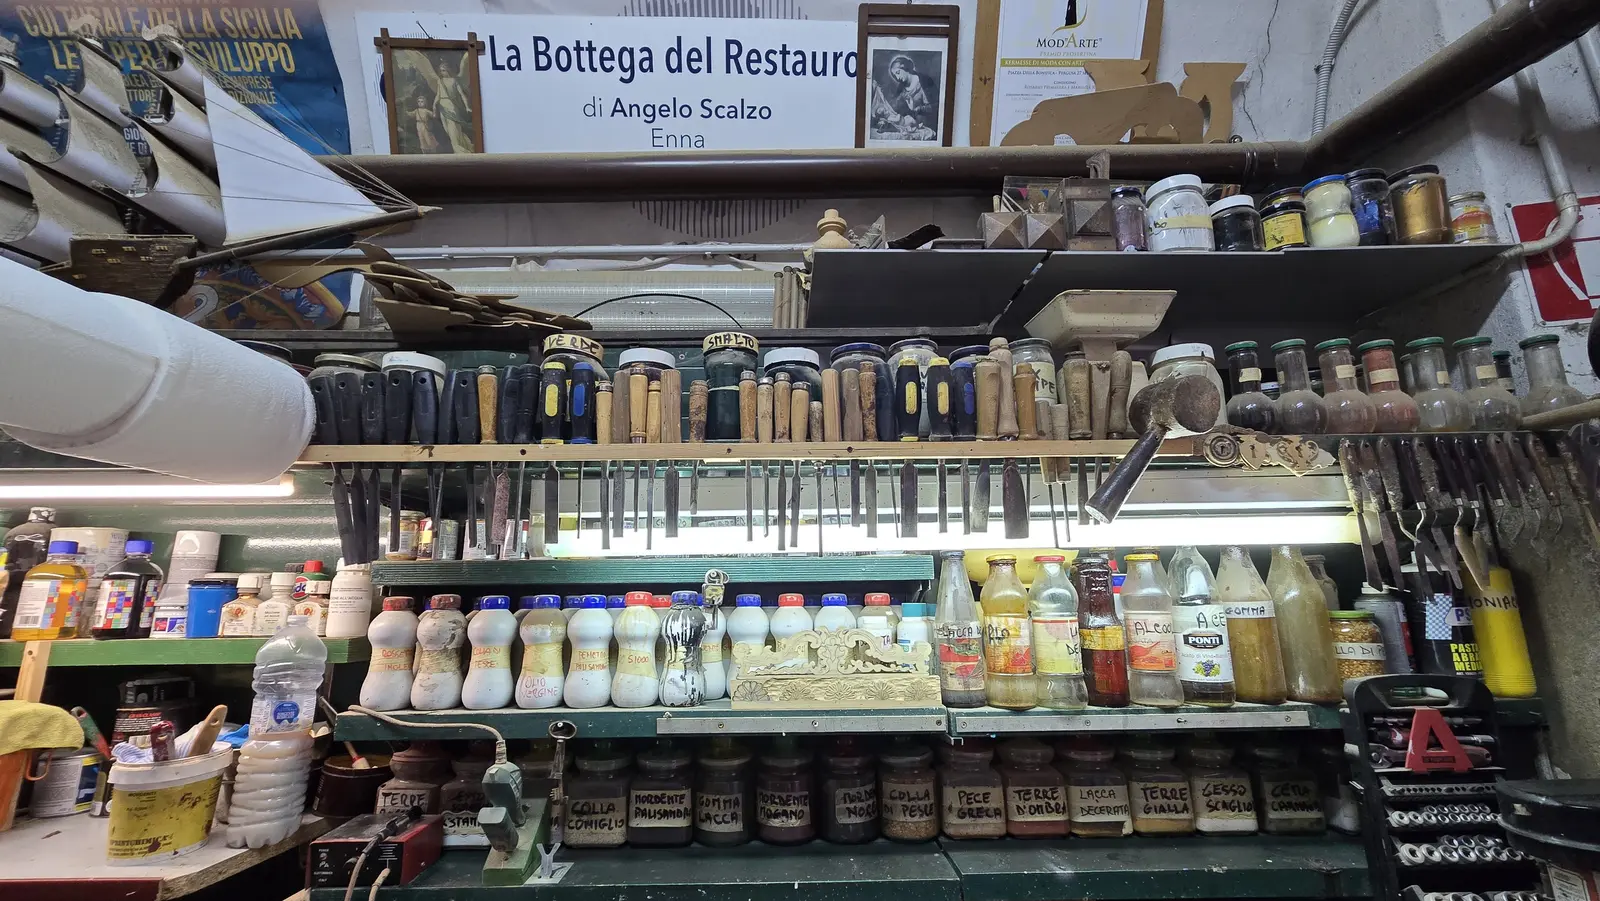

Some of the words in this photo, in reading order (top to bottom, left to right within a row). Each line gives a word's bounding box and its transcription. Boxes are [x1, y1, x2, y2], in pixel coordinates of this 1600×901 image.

[148, 7, 221, 38] DELLA
[219, 7, 303, 40] SICILIA
[489, 34, 522, 71] La
[532, 35, 655, 84] Bottega
[665, 36, 712, 74] del
[725, 38, 858, 78] Restauro
[127, 89, 157, 102] TTORE
[582, 96, 603, 118] di
[610, 97, 693, 124] Angelo
[700, 99, 772, 120] Scalzo
[651, 128, 706, 148] Enna
[548, 333, 600, 354] VERDE
[708, 333, 754, 350] SMALTO
[1225, 605, 1266, 616] GOMMA
[1188, 636, 1220, 644] PONTI
[889, 788, 931, 802] COLLA
[957, 790, 991, 805] PECE
[1012, 786, 1060, 802] TERRE
[1079, 789, 1116, 800] LACCA
[571, 801, 616, 816] COLLA
[902, 803, 935, 818] PESCE
[956, 806, 1002, 819] GRECA
[1079, 803, 1130, 816] DECERATA
[1143, 802, 1190, 814] GIALLA
